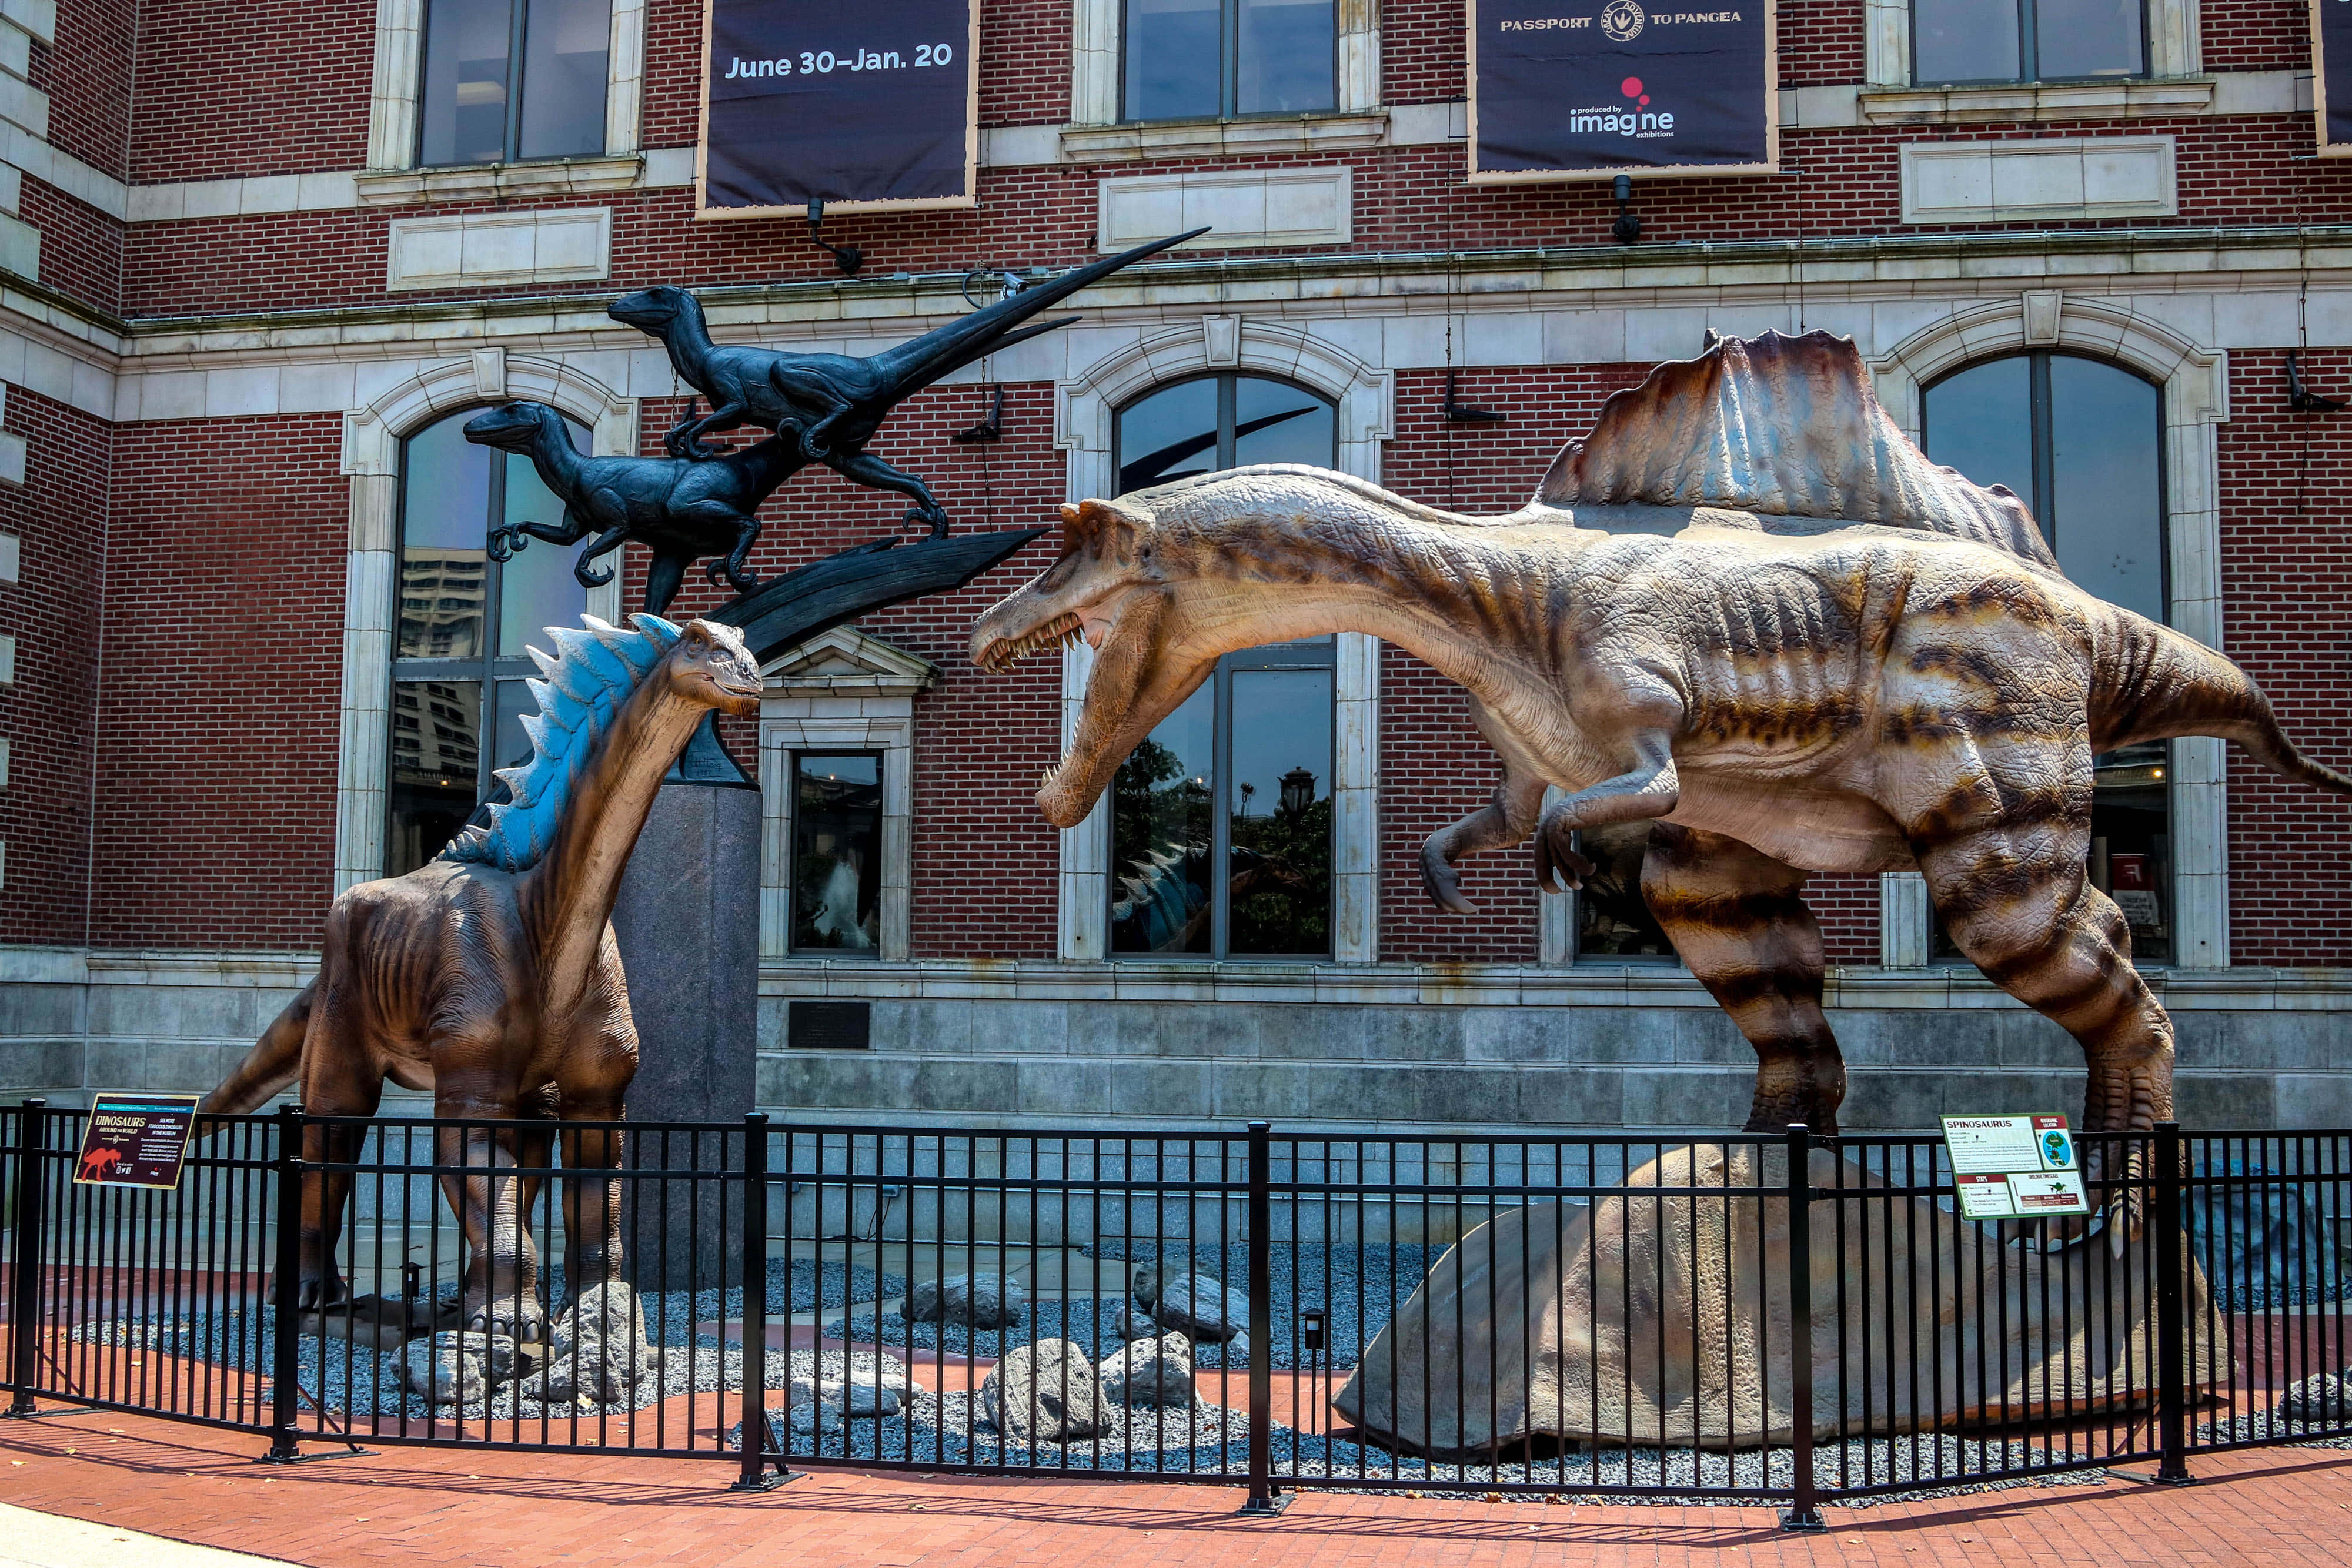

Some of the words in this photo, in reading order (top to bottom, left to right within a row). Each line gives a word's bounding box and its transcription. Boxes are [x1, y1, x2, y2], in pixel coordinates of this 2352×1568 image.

[1501, 17, 1592, 31] PASSPORT
[1651, 14, 1672, 25] TO
[1675, 11, 1742, 24] PANGEA
[1603, 8, 1613, 34] GREAT
[1623, 2, 1643, 39] ADVENTURE
[724, 56, 792, 79] June
[914, 43, 953, 68] 20
[1578, 106, 1612, 115] produced
[95, 1115, 146, 1127] DINOSAURS
[1946, 1120, 2012, 1128] SPINOSAURUS
